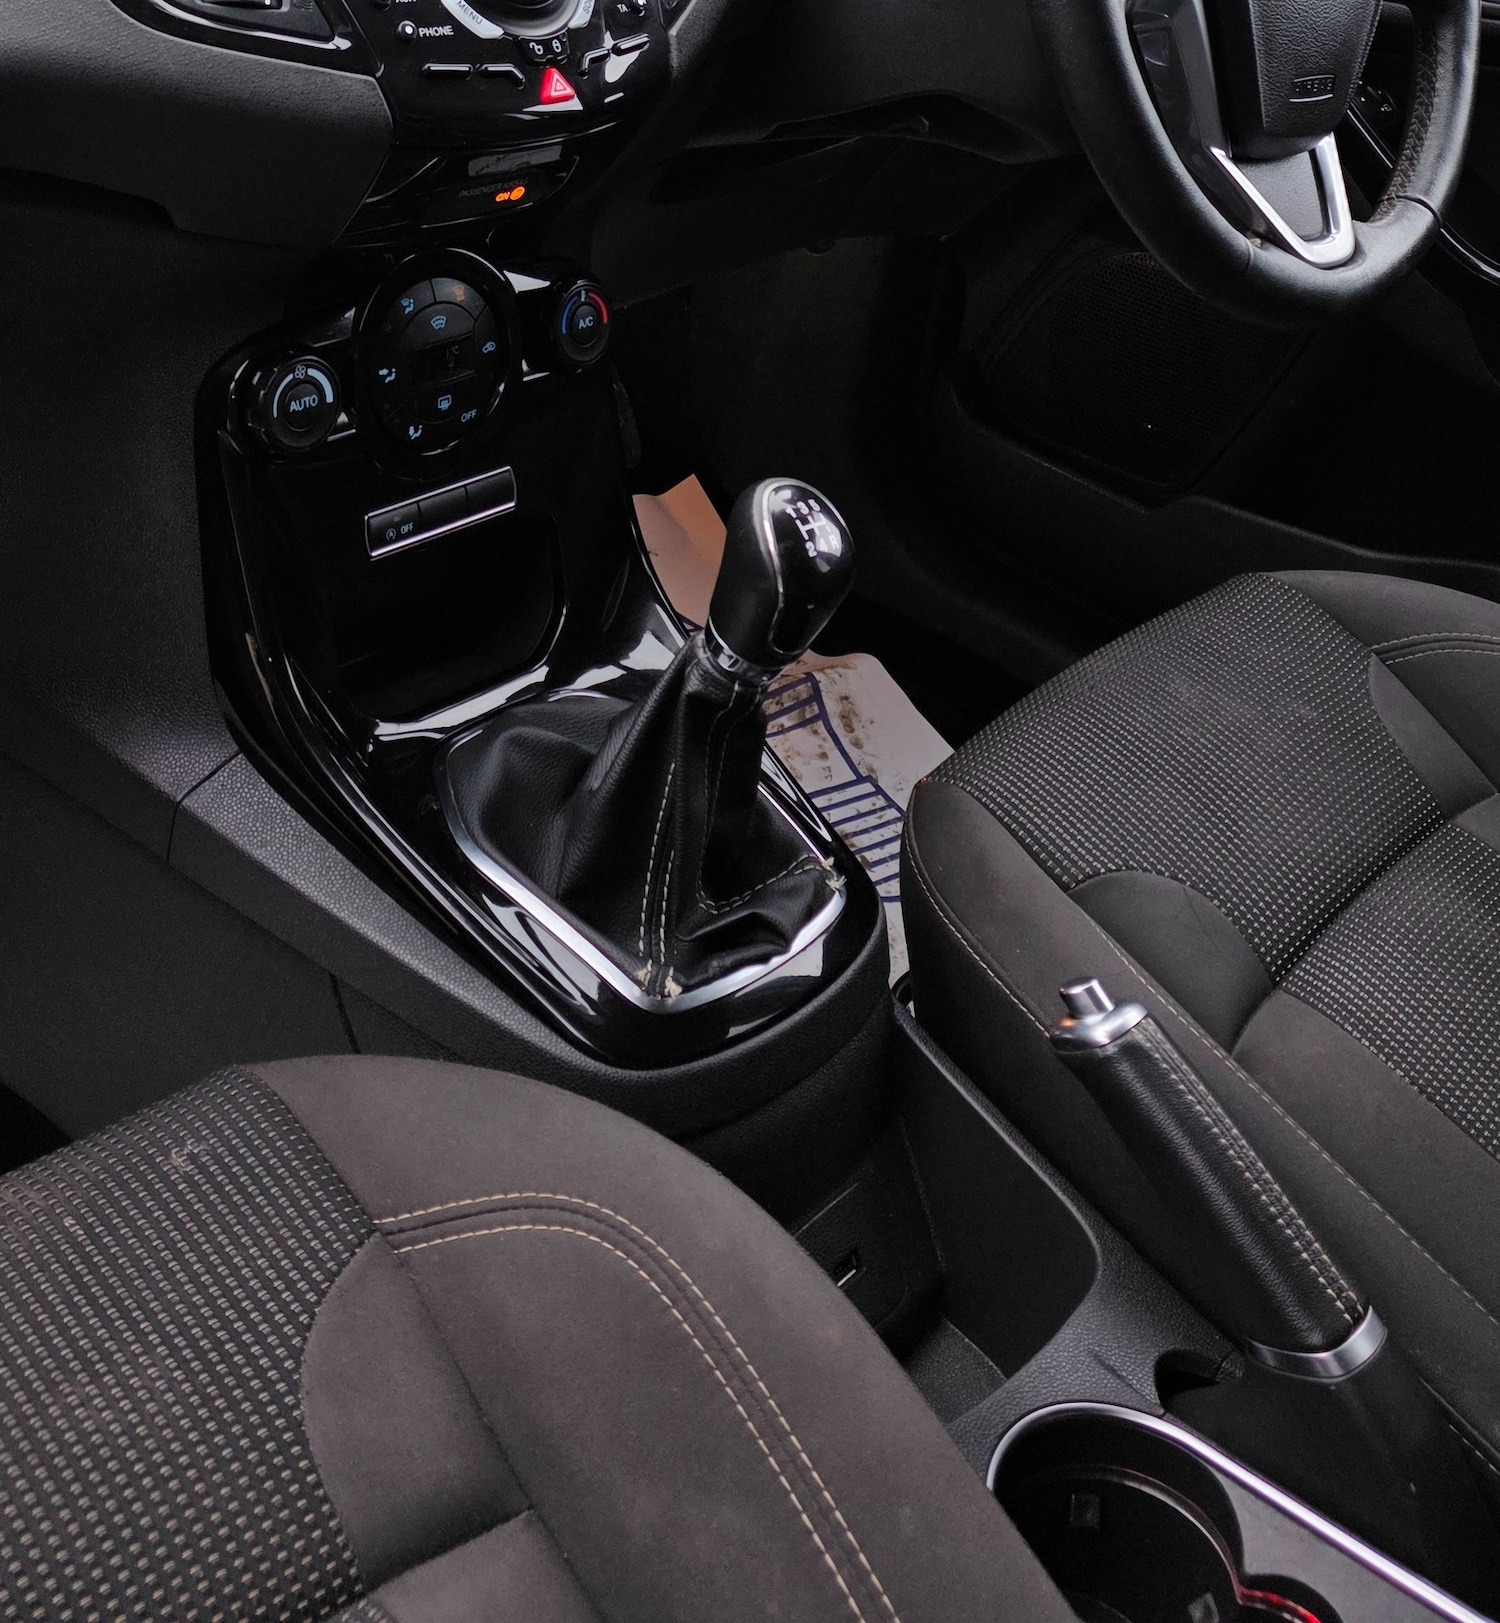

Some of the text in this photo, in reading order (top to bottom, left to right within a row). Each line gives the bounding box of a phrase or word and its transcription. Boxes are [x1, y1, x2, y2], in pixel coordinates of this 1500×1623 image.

[456, 0, 484, 25] MENU
[418, 25, 455, 38] PHONE
[578, 316, 594, 329] A/C
[289, 395, 319, 412] AUTO
[461, 409, 477, 422] OFF
[805, 540, 818, 558] 2
[828, 534, 840, 551] R
